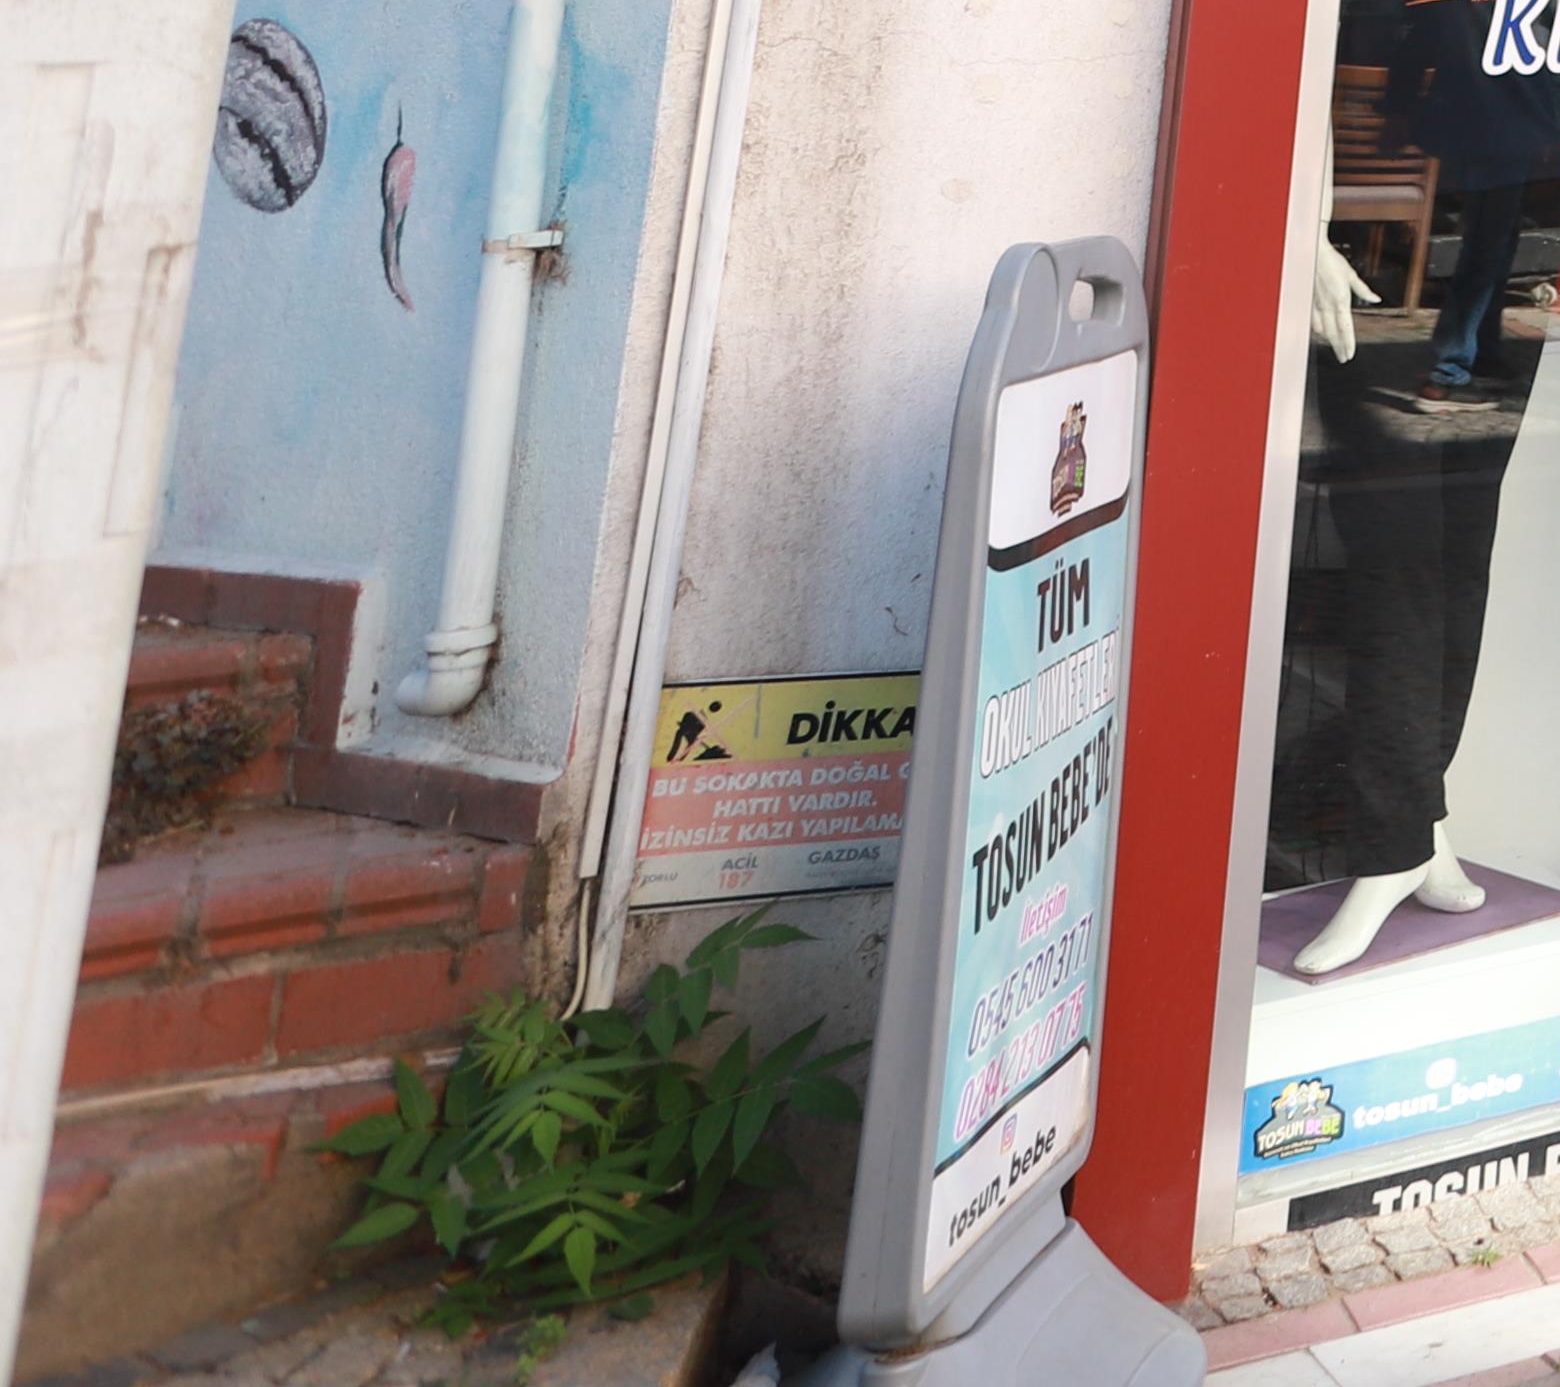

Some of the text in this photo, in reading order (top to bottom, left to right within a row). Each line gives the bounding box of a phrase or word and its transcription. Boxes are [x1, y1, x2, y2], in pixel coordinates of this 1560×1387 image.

[1036, 557, 1091, 654] TÜM
[786, 700, 917, 746] DİKKA
[979, 615, 1121, 779] OKUL KIYAFETLERİ
[652, 778, 687, 798] BU
[692, 768, 804, 795] SOKAKTA
[810, 759, 892, 786] DOĞAL
[713, 789, 878, 819] HATTI VARDIR.
[639, 812, 903, 852] İZİNSİZ KAZI YAPILAM
[972, 715, 1115, 934] TOSUN BEBE'DE
[721, 845, 882, 872] ACİL GAZDAŞ
[966, 987, 1016, 1062] 0545
[1013, 943, 1054, 1021] 600
[1352, 1072, 1525, 1130] tosun_bebe
[1257, 1119, 1306, 1153] TOSUN
[947, 1124, 1058, 1249] tosun_bebe
